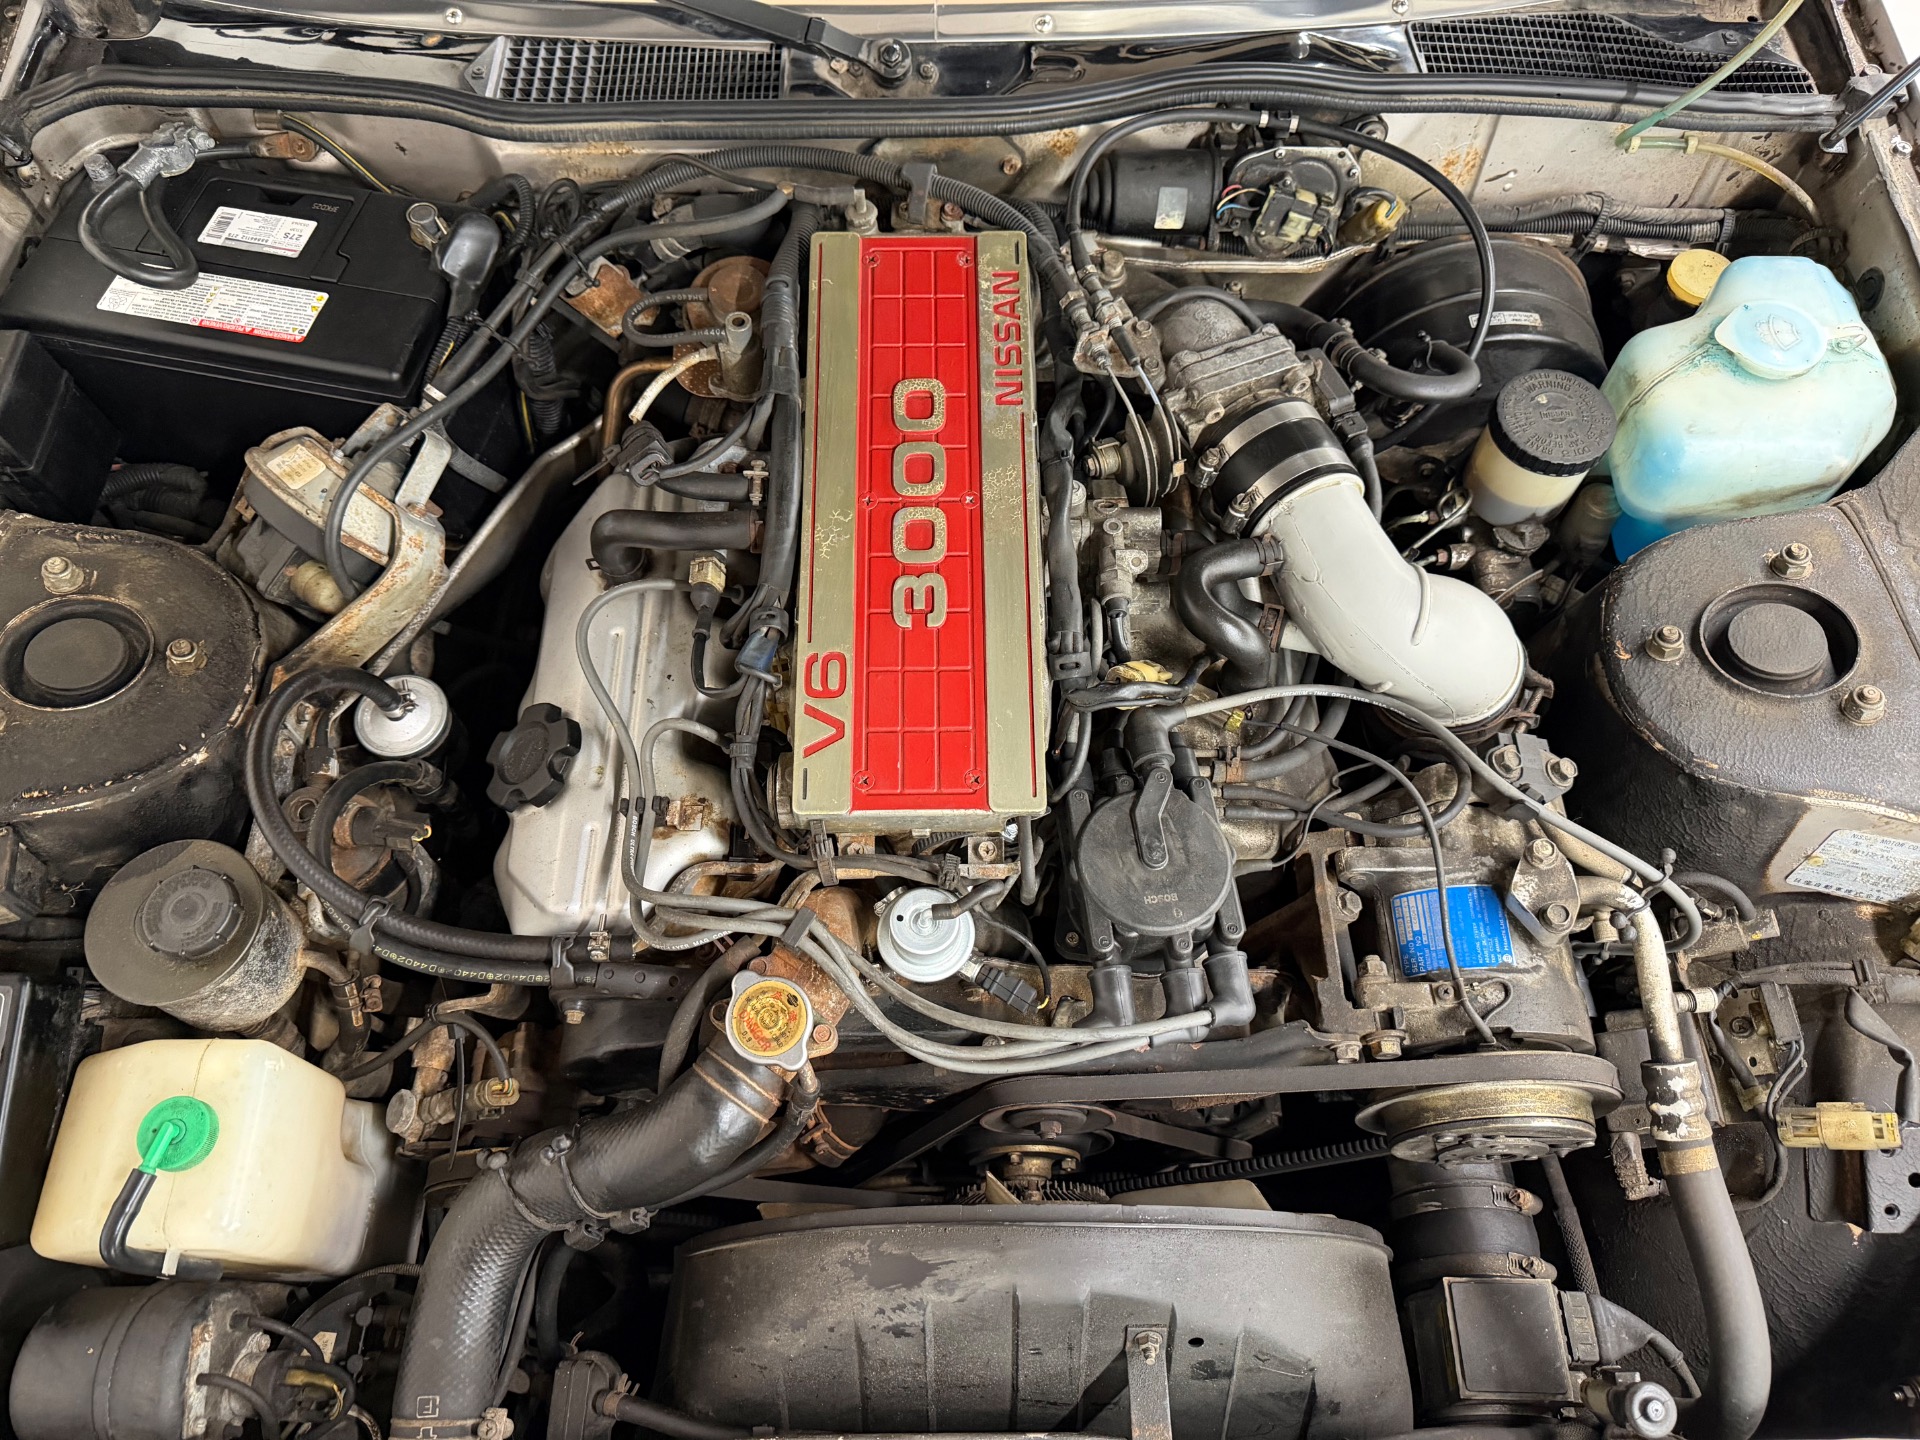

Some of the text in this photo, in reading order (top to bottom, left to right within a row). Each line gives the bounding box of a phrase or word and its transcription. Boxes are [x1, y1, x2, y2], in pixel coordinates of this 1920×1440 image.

[283, 232, 303, 241] 27S
[992, 270, 1024, 406] NISSAN
[1524, 380, 1572, 394] WARNING
[1540, 410, 1574, 419] NISSAN
[892, 378, 948, 630] 3000
[802, 651, 846, 758] V6
[1143, 892, 1178, 904] BOSCH
[692, 937, 710, 946] MAG
[1402, 953, 1411, 974] TYPE
[1417, 952, 1426, 972] PART
[738, 1009, 772, 1052] DANGER
